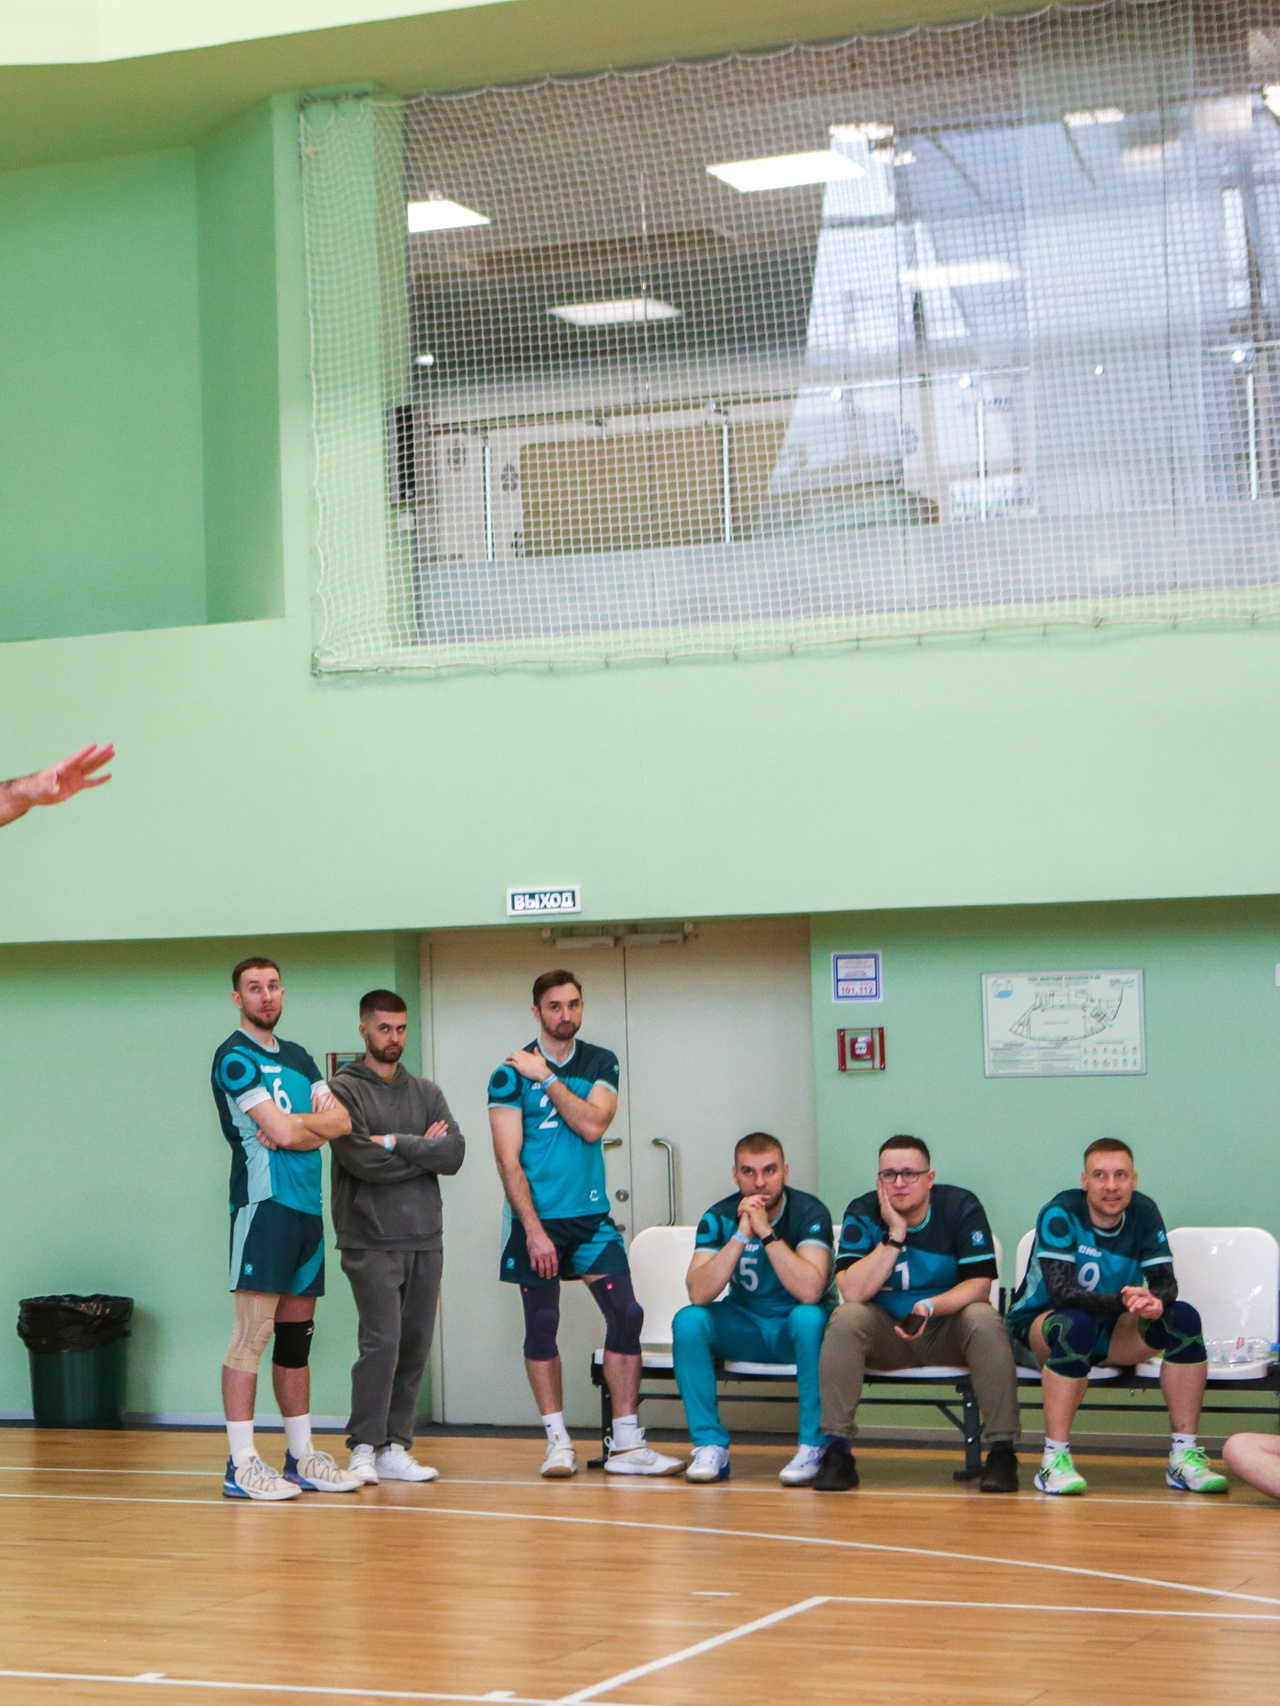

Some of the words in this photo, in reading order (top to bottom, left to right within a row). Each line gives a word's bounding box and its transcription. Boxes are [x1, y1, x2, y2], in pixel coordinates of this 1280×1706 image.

[513, 892, 574, 910] ВЫХОД
[273, 1077, 292, 1115] 6
[539, 1094, 559, 1130] 2
[1078, 1262, 1100, 1292] 9
